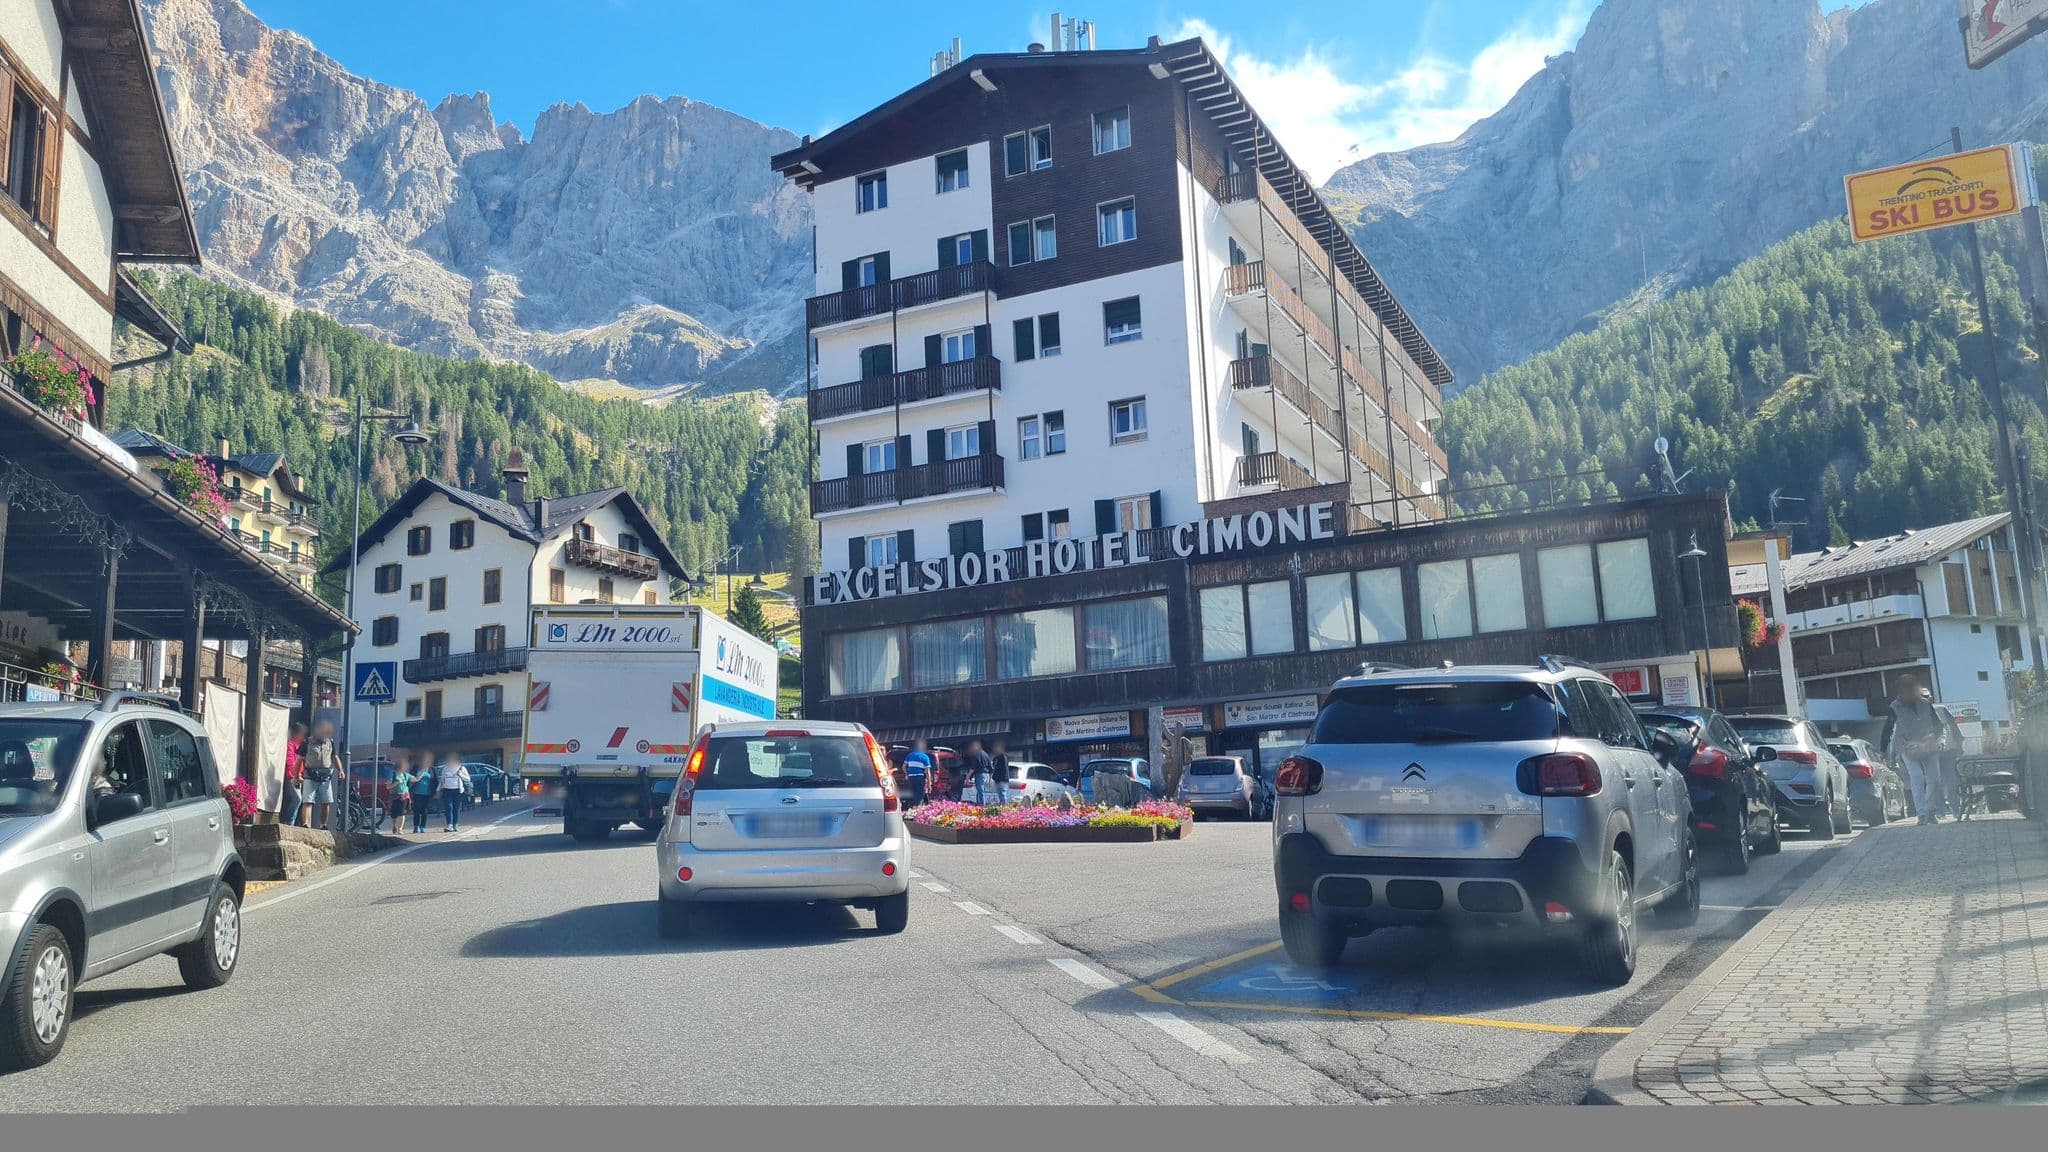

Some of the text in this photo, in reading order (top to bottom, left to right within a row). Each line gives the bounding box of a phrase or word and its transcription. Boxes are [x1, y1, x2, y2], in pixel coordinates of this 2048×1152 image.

[1879, 181, 1985, 208] TRENTINO TRASPORTI
[1869, 189, 2000, 231] SKI BUS
[813, 500, 1335, 606] EXCELSIOR HOTEL CIMONE
[573, 623, 618, 643] LM
[619, 626, 672, 643] 2000
[1065, 728, 1075, 736] San
